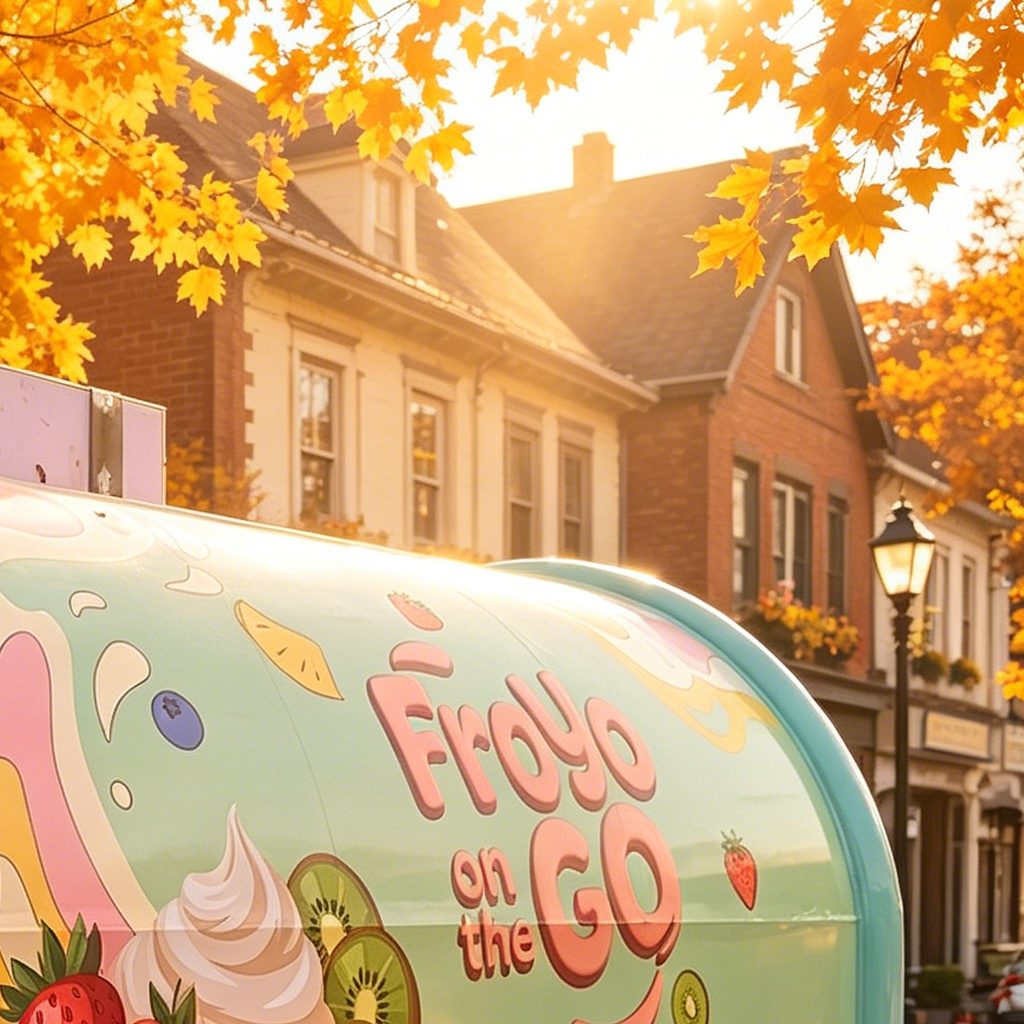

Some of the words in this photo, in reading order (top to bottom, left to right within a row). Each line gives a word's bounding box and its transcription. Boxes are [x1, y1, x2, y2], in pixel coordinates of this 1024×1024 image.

[451, 847, 517, 909] on
[530, 802, 682, 989] GO
[457, 908, 536, 982] the
